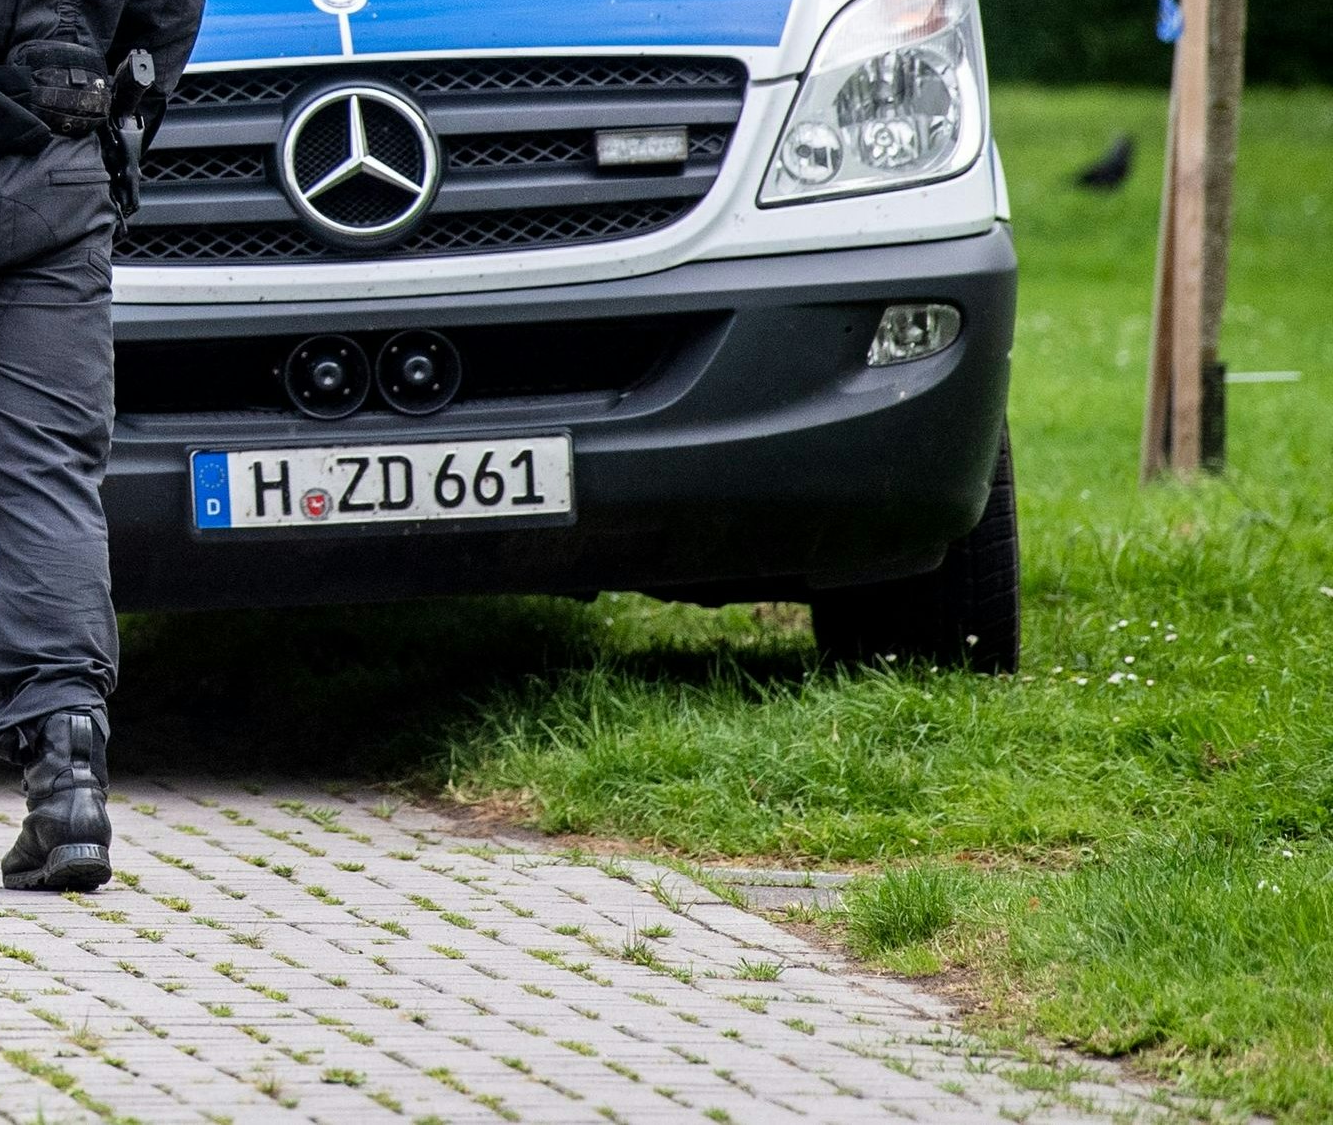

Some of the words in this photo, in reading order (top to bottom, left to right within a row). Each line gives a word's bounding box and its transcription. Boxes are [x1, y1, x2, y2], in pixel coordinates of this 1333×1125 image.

[253, 459, 292, 517] H
[336, 454, 415, 513] ZD
[433, 449, 545, 509] 661
[207, 498, 221, 516] D
